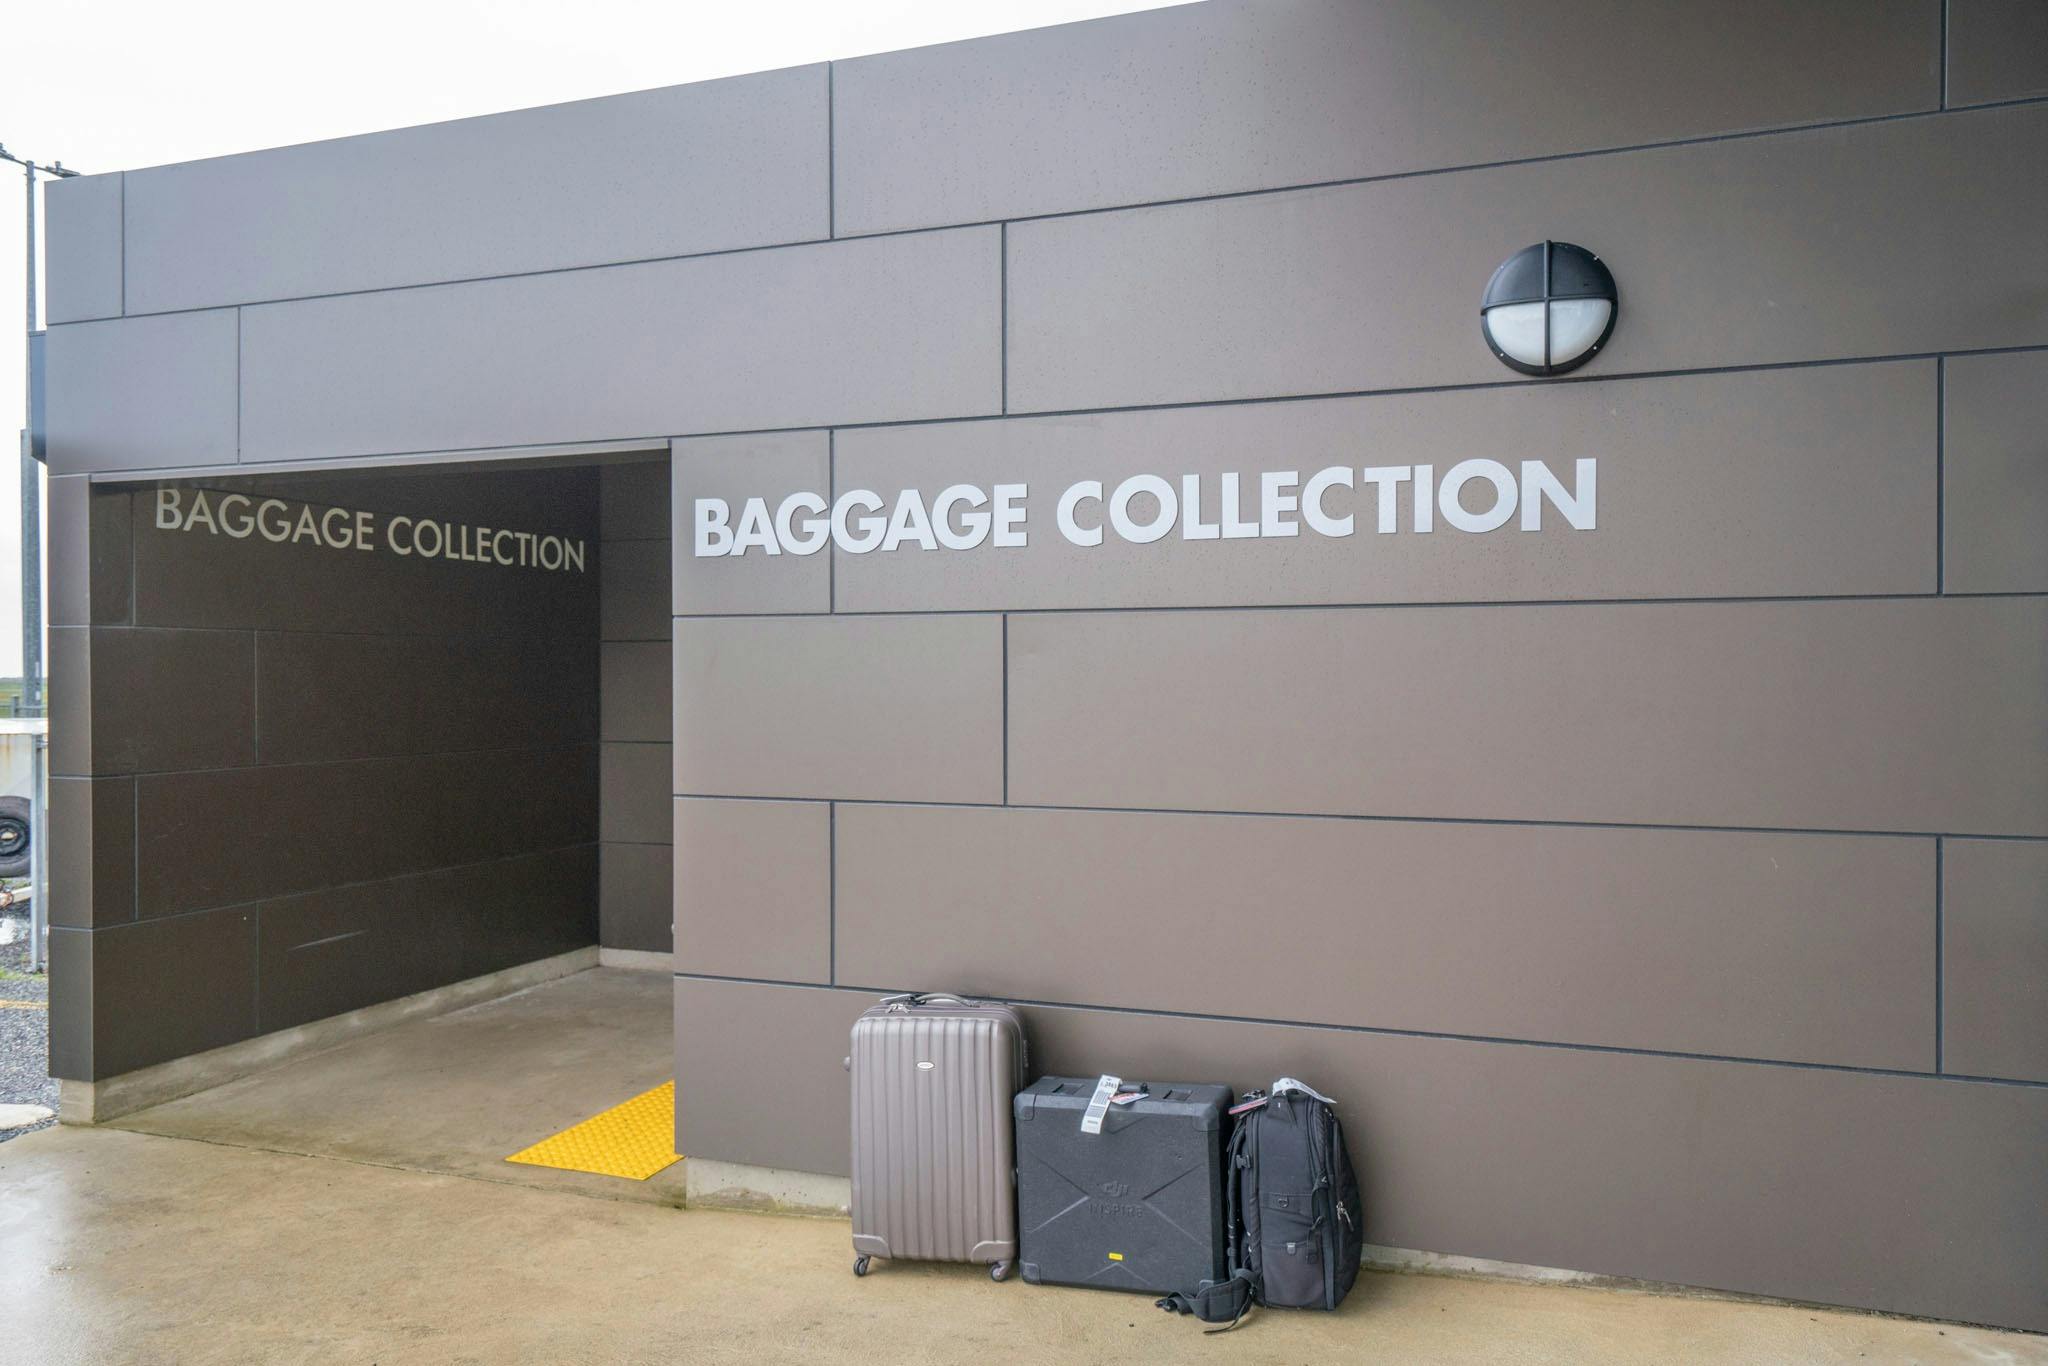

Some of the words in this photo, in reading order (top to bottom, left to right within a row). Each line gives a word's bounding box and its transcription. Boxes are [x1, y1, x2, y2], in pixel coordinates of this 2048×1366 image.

[155, 488, 374, 551] BAGGAGE
[387, 516, 584, 573] COLLECTION
[694, 482, 1028, 557] BAGGAGE
[1056, 458, 1597, 547] COLLECTION
